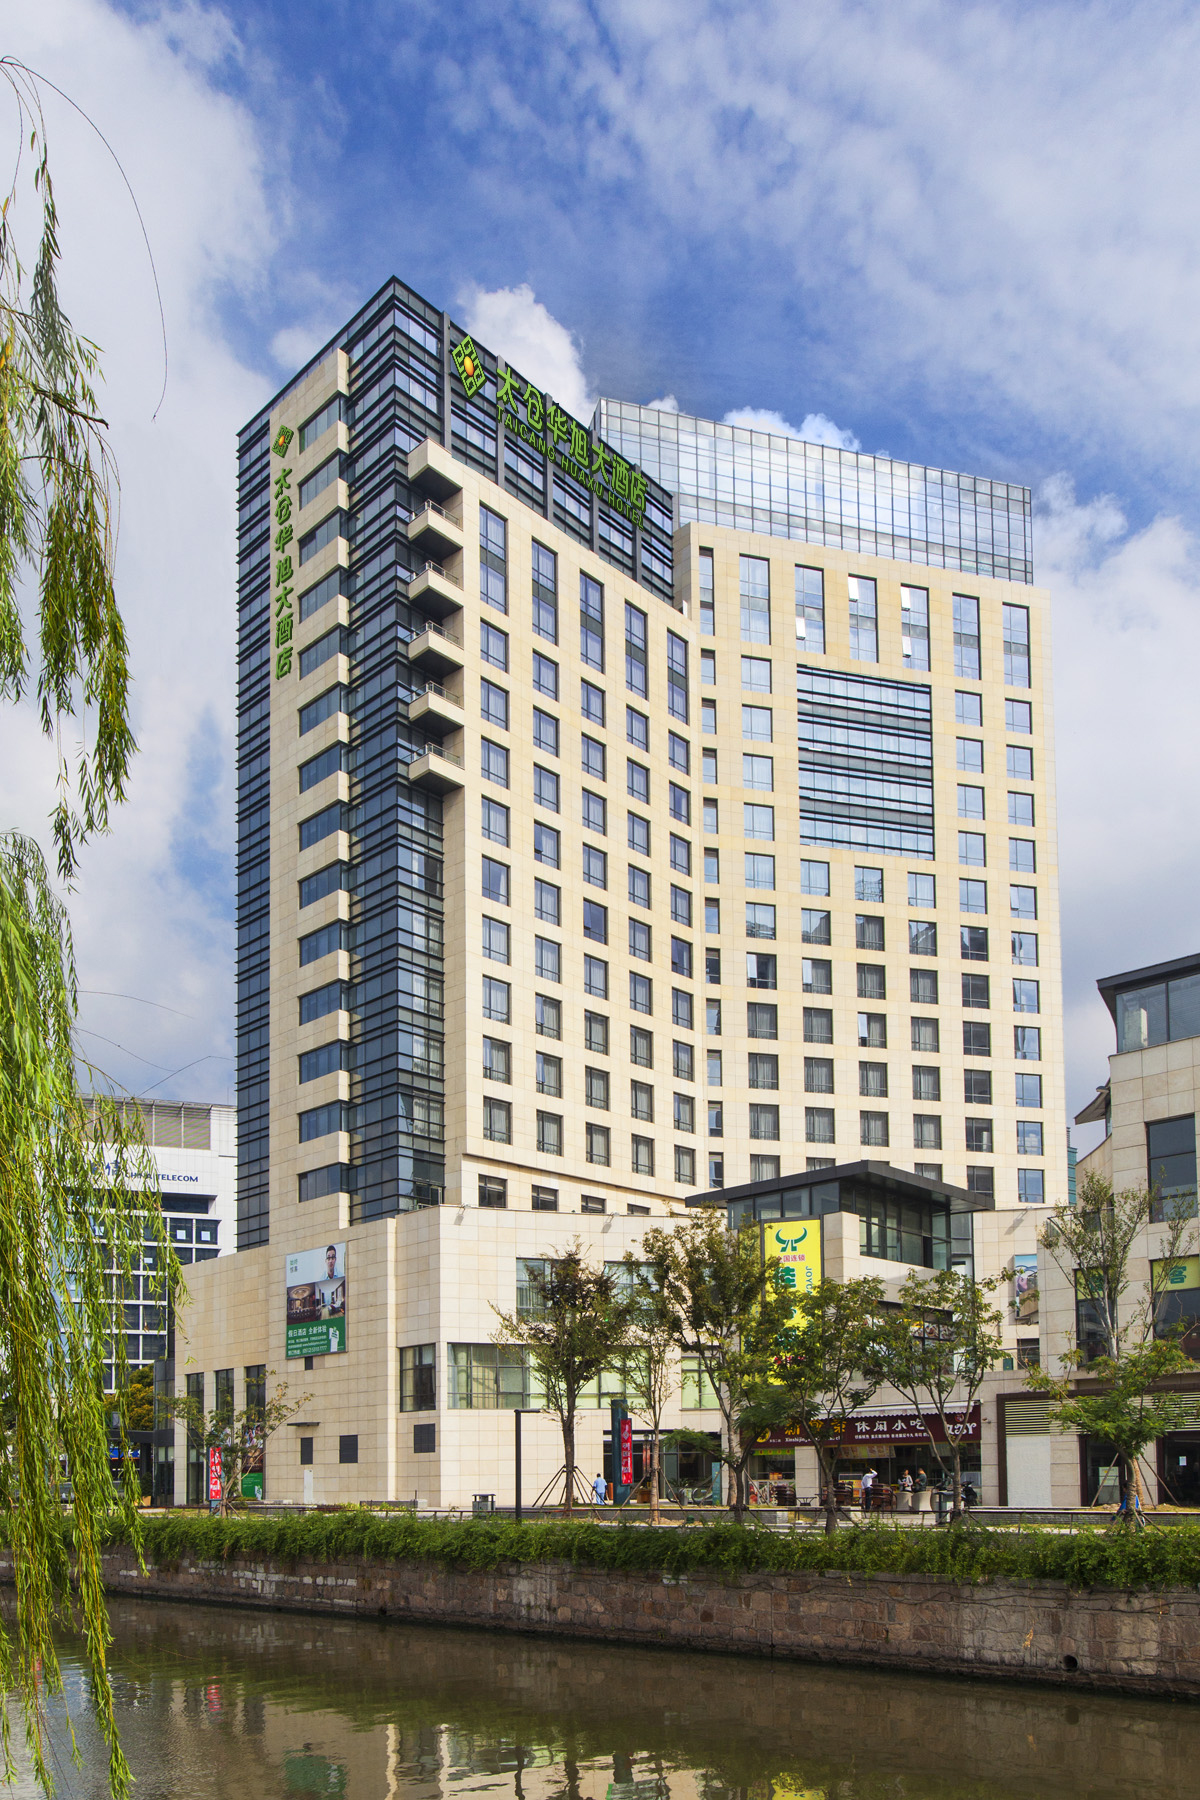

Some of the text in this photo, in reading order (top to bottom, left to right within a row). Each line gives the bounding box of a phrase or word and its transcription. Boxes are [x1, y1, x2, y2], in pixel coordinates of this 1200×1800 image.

[496, 366, 648, 513] 太仓华旭大酒店
[496, 404, 645, 531] TAICANG HUAXU HOTEL
[273, 467, 294, 681] 太仓华旭大酒店
[156, 1173, 199, 1183] TELECOM
[855, 1417, 926, 1433] 休闲小吃
